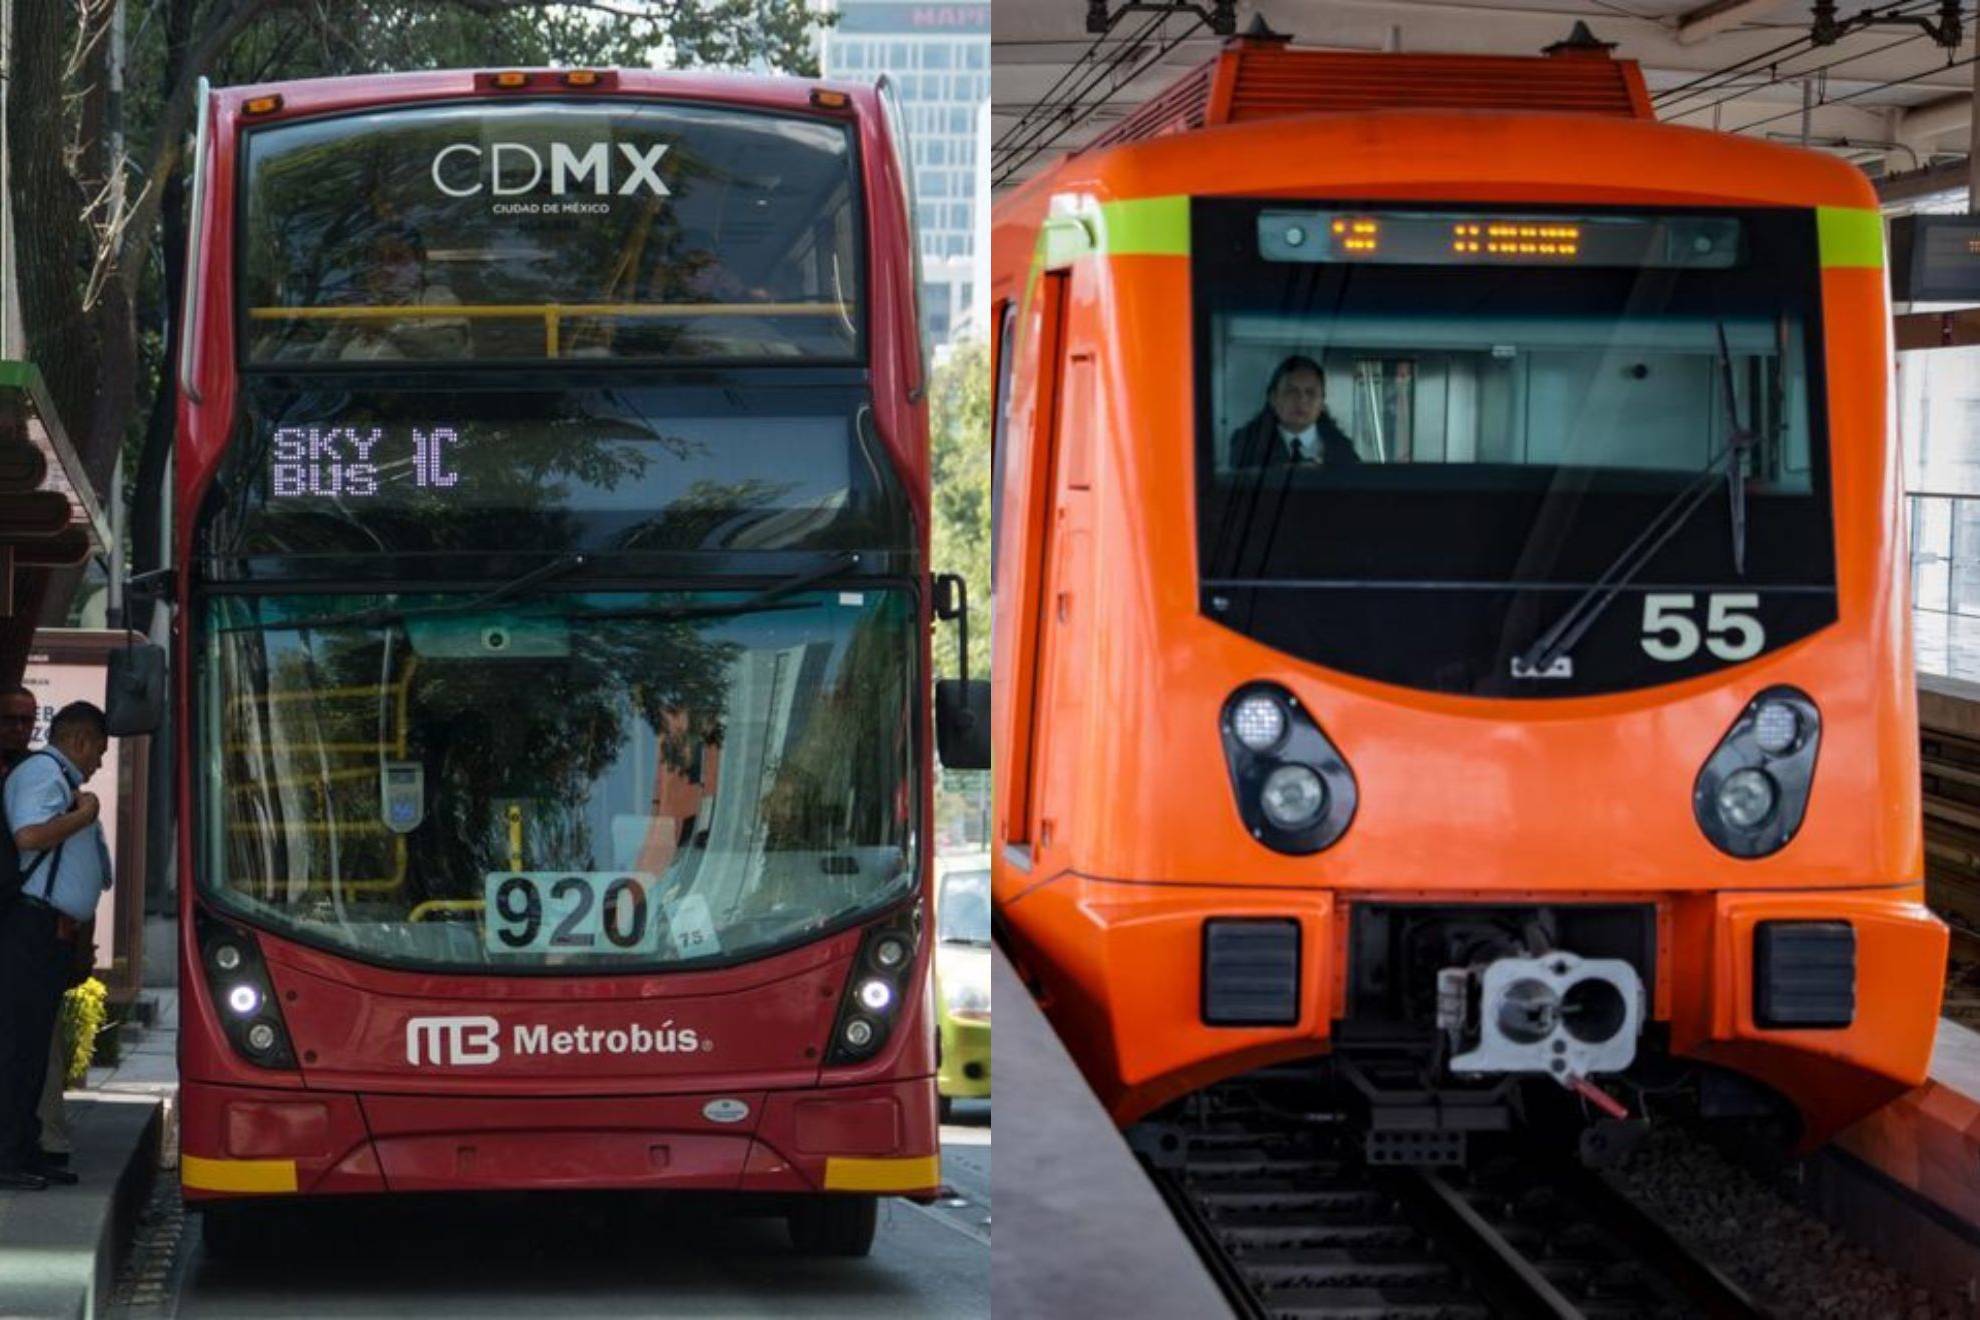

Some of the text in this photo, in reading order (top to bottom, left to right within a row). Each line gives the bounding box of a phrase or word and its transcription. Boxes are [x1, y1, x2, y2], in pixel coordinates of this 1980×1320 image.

[431, 142, 672, 198] CDMX
[492, 201, 610, 214] CIUDAD DE MÉXICO
[274, 428, 382, 460] SKY
[412, 428, 458, 487] 1C
[274, 464, 377, 496] BUS
[1640, 593, 1766, 662] 55
[495, 876, 648, 948] 920
[513, 1019, 699, 1055] Metrobús
